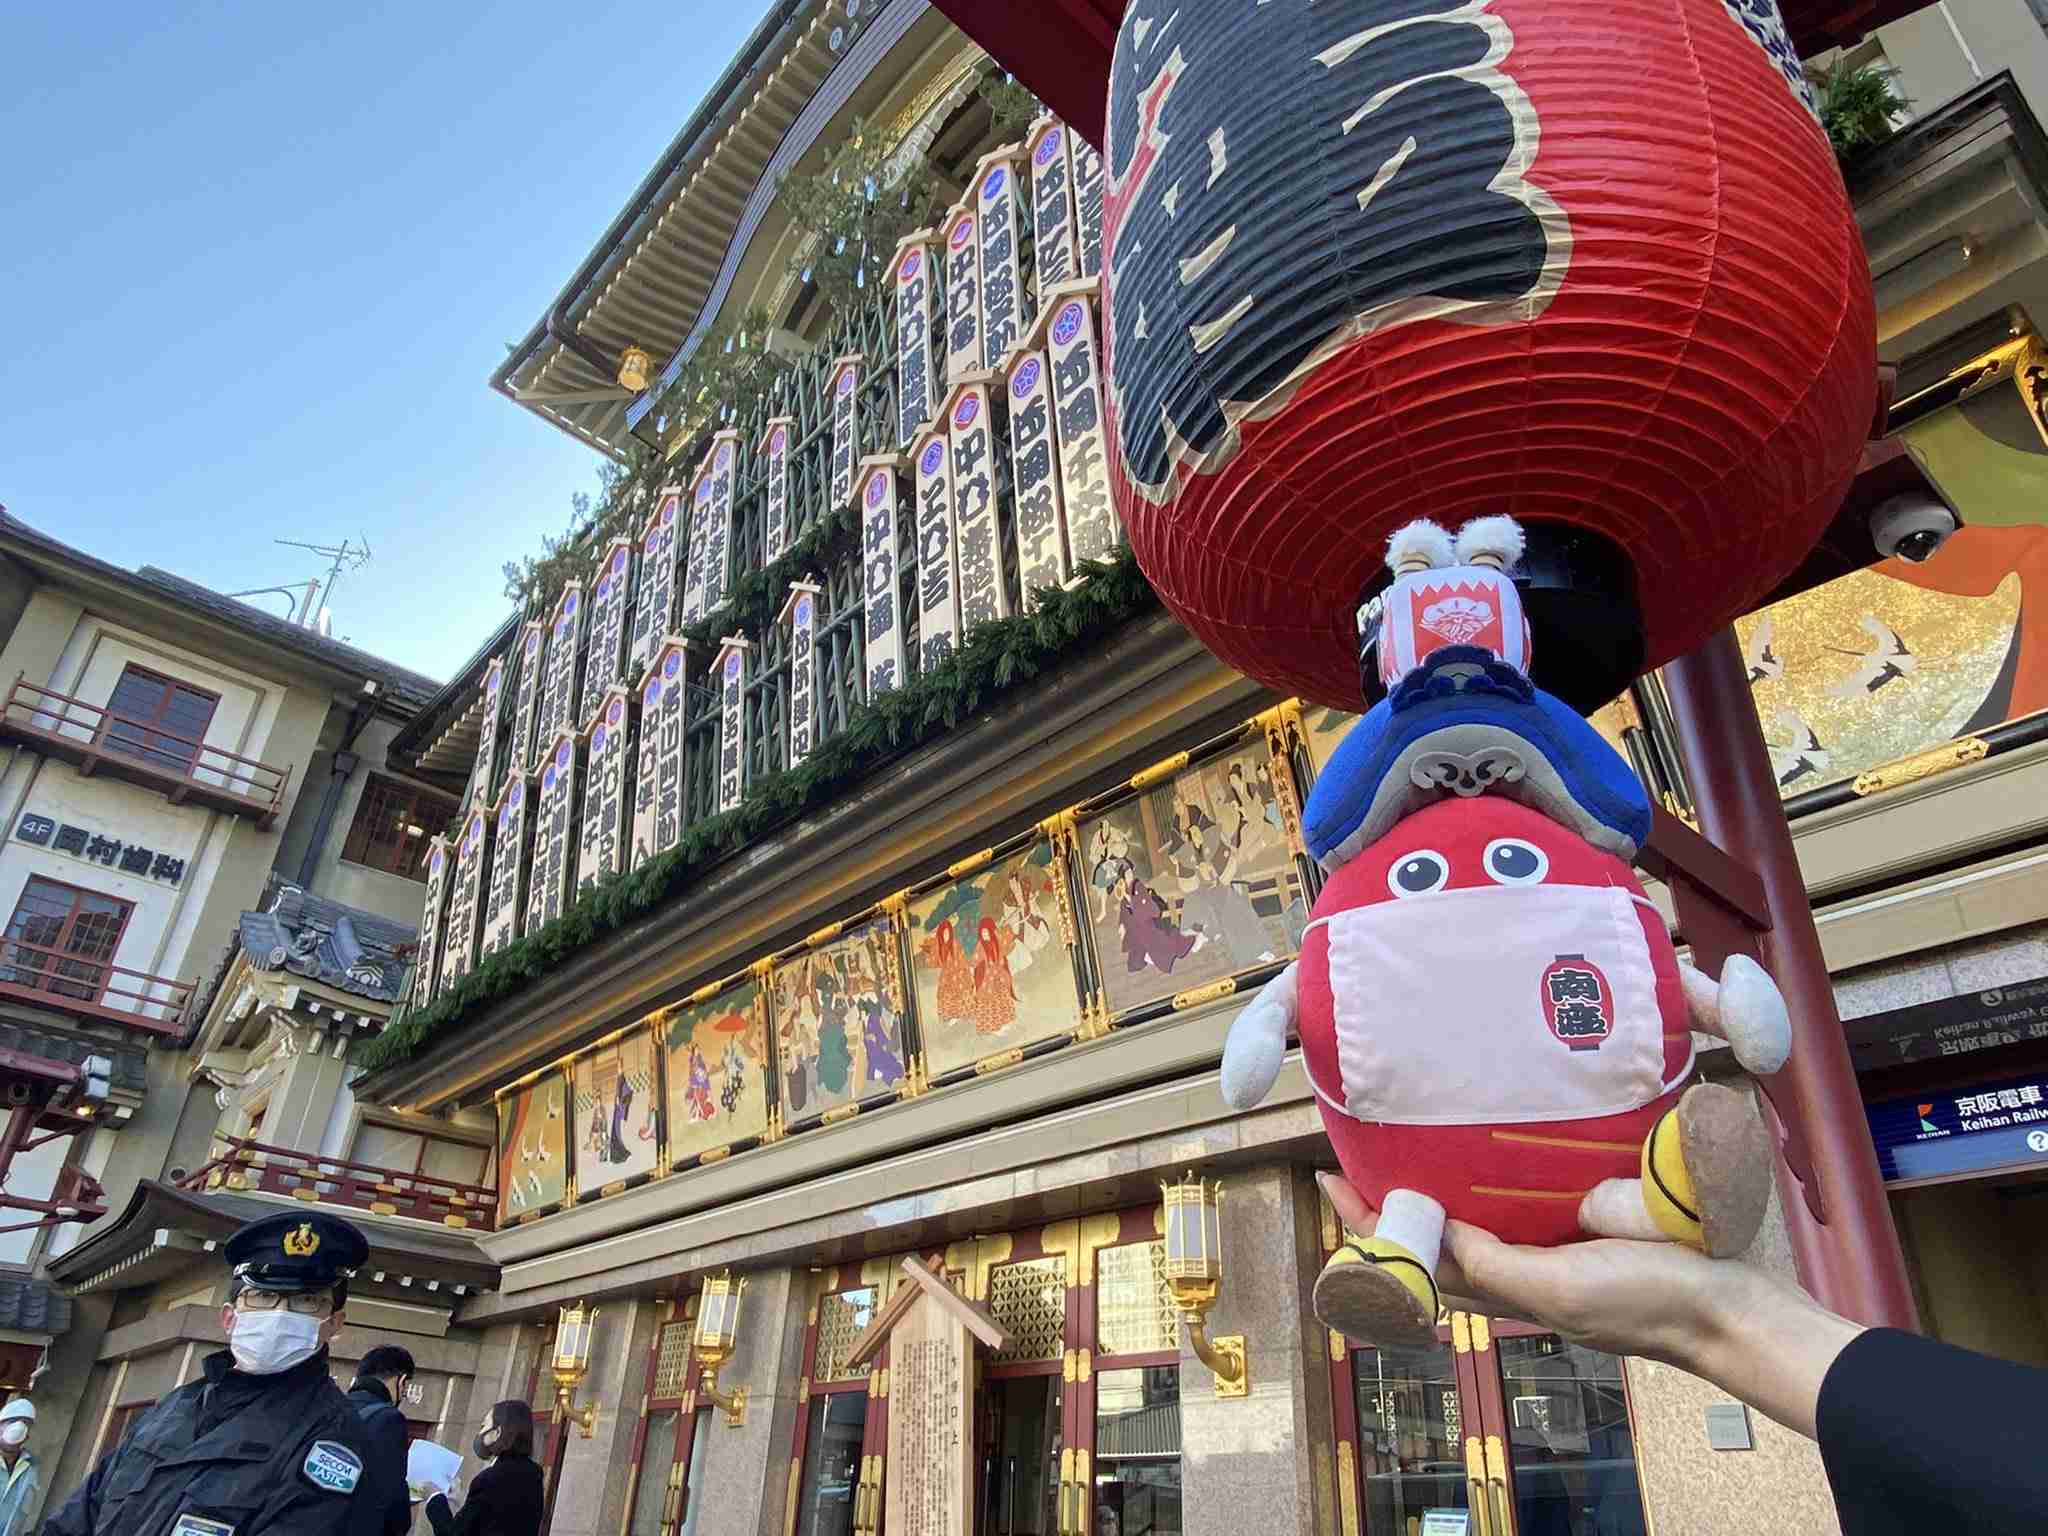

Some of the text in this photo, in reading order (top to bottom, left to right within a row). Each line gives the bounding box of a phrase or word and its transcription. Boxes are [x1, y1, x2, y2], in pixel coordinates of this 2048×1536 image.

[23, 821, 51, 835] 4F
[1955, 1085, 2043, 1116] 京阪電車
[1961, 1116, 2010, 1132] Keihan
[318, 1453, 353, 1477] SECOM
